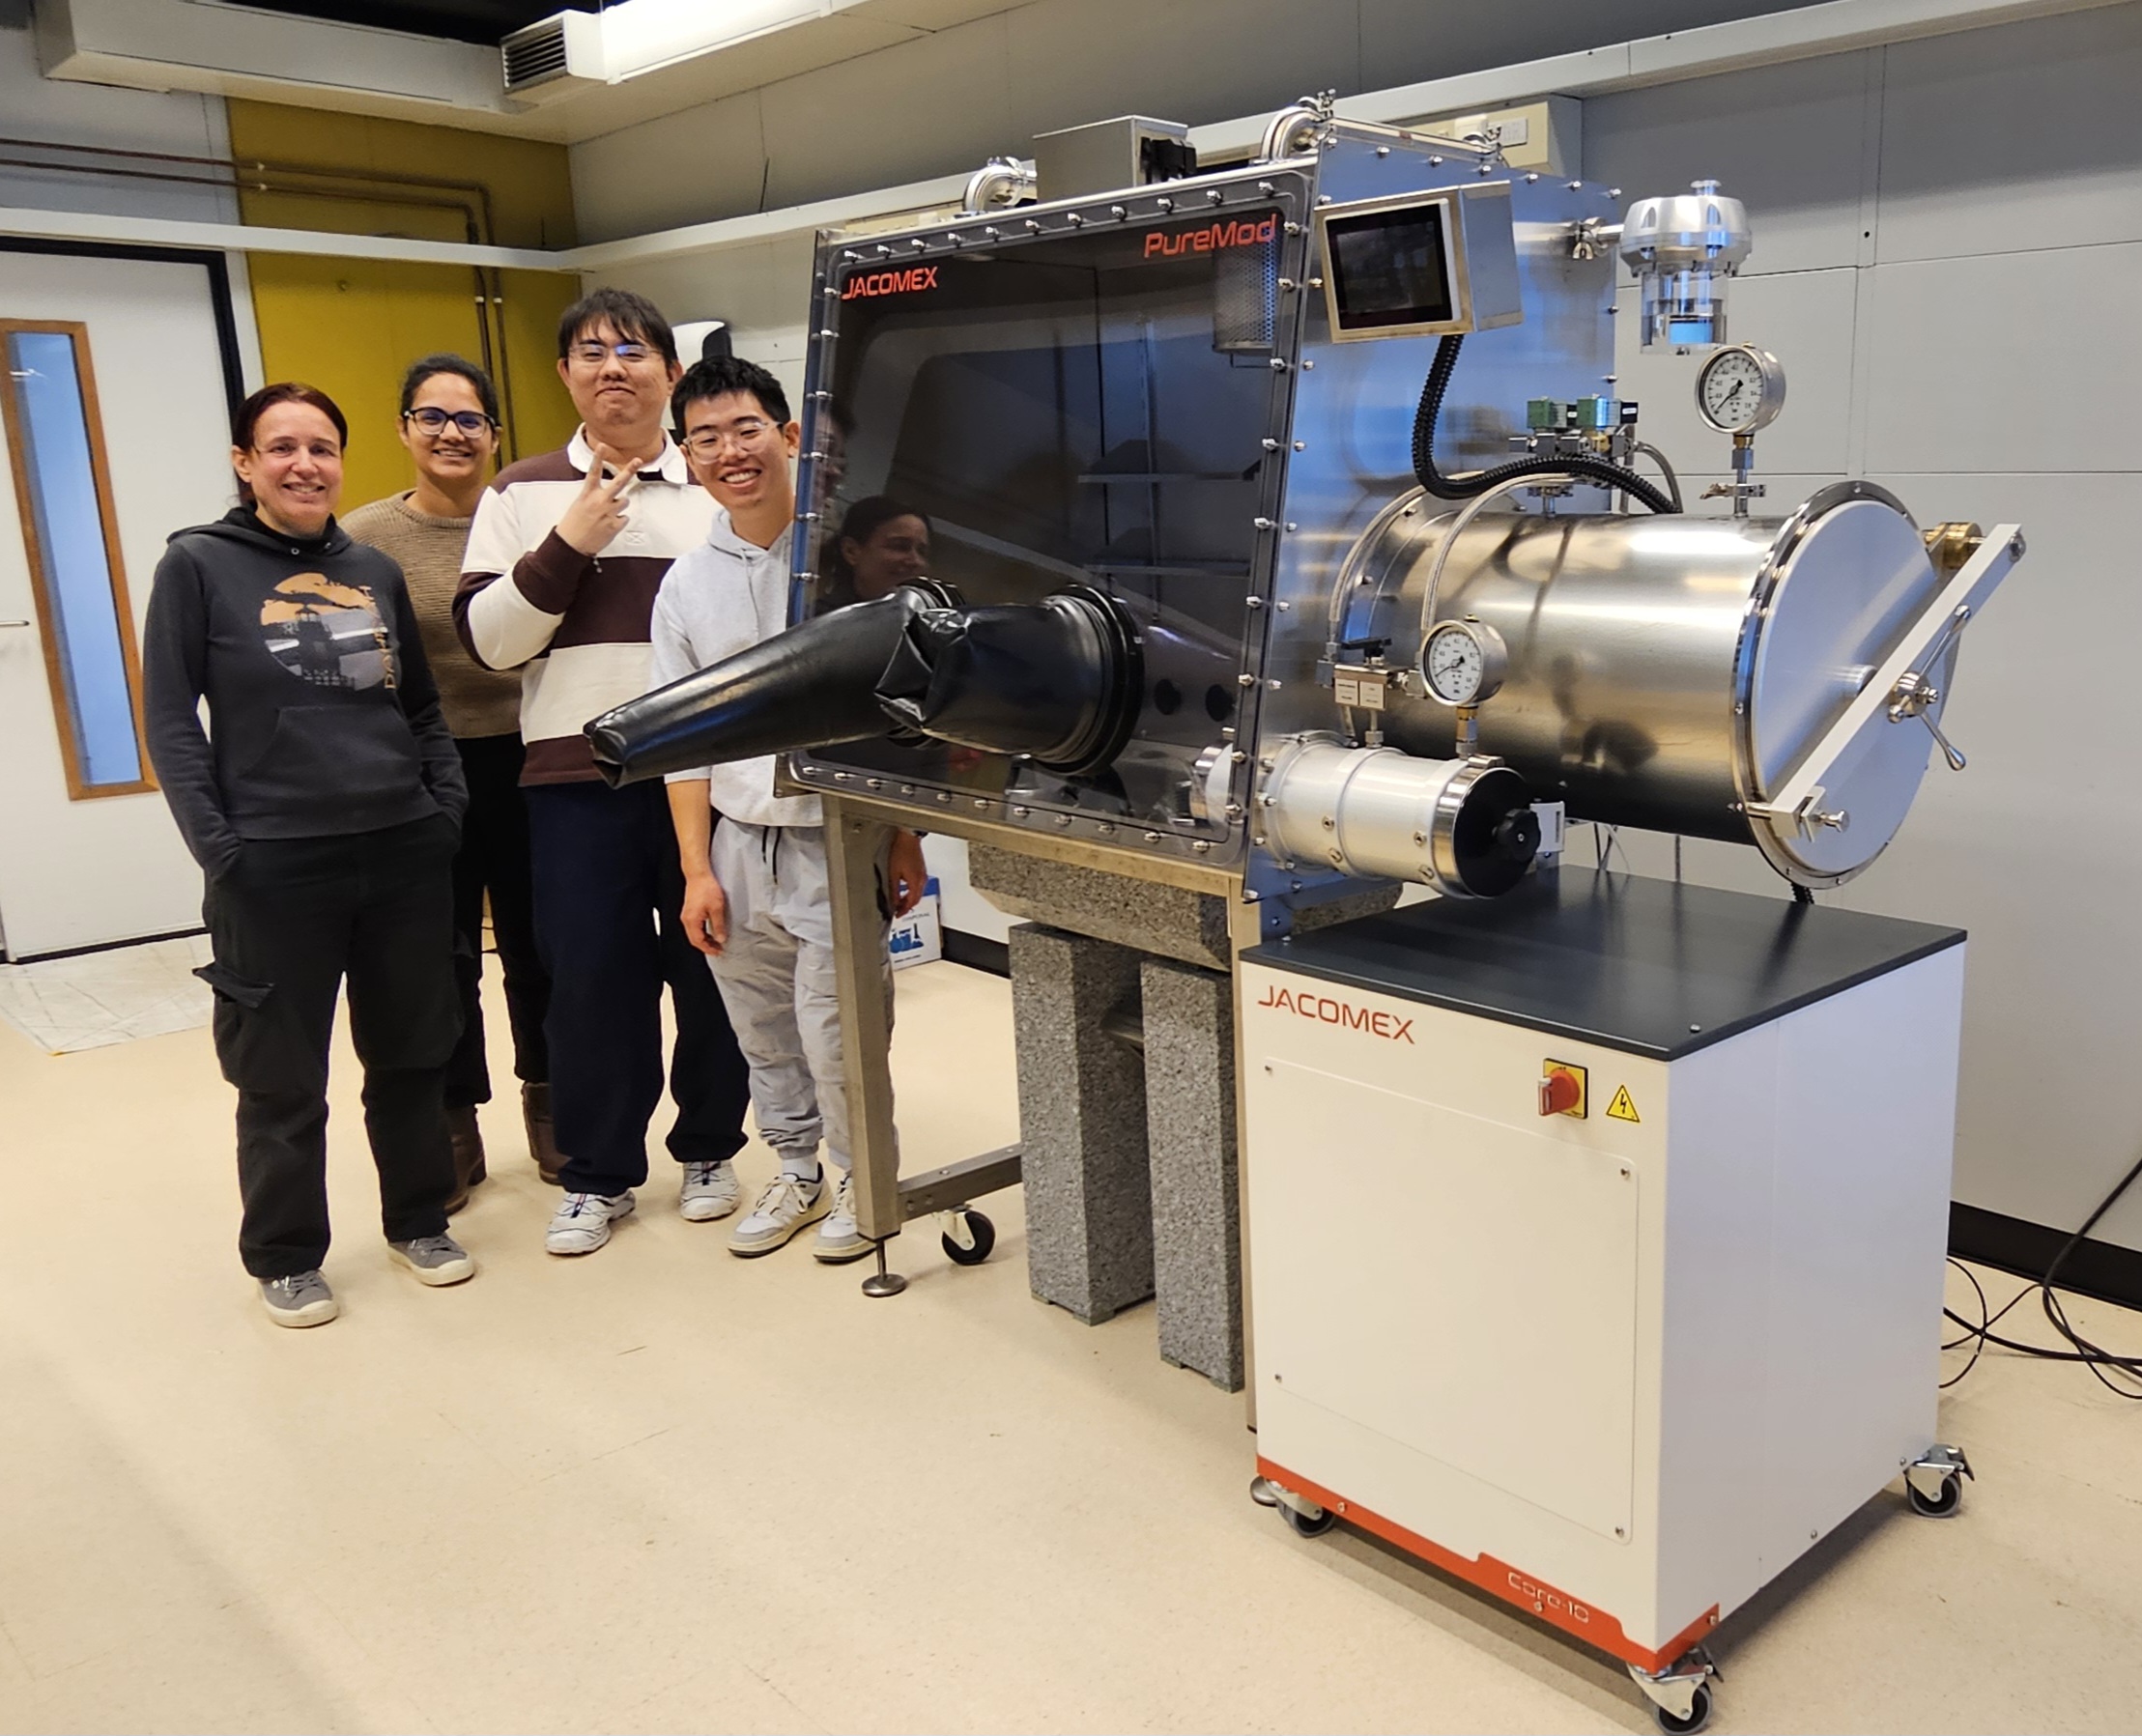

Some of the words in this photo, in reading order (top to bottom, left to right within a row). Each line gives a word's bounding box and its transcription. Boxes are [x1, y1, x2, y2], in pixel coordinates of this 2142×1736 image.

[1144, 213, 1276, 258] PureMod
[842, 266, 938, 299] JACOMEX
[1258, 985, 1414, 1044] JACOMEX
